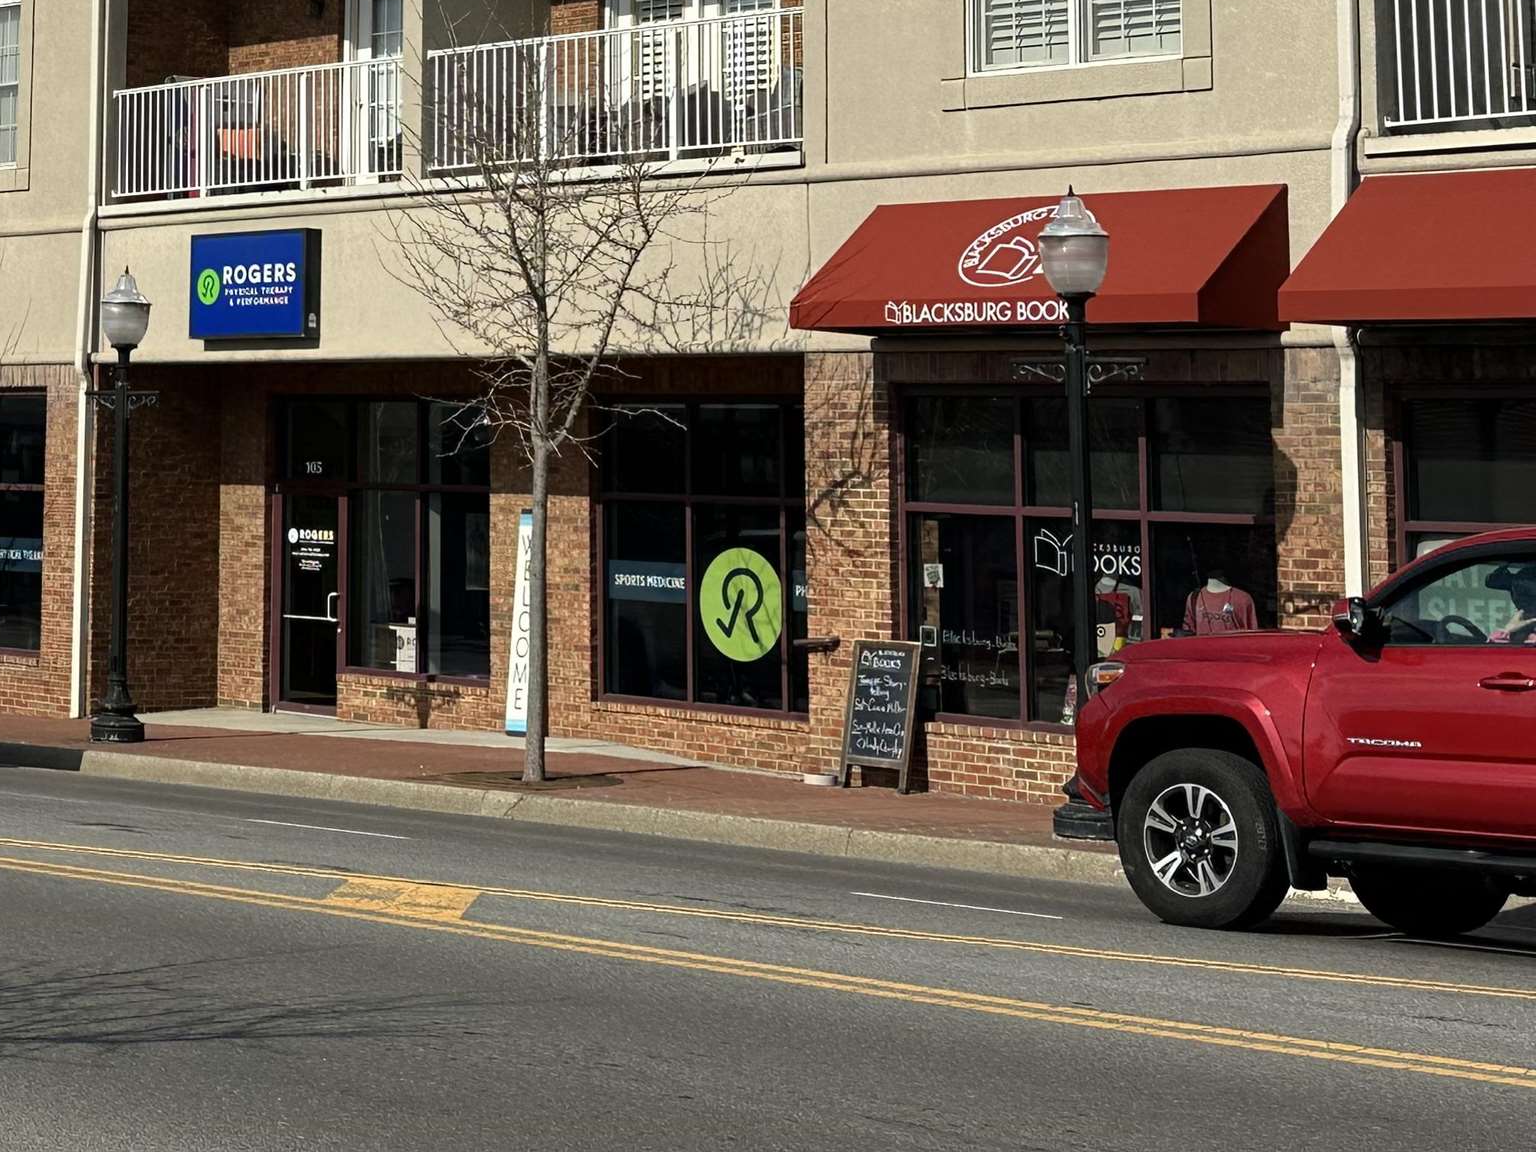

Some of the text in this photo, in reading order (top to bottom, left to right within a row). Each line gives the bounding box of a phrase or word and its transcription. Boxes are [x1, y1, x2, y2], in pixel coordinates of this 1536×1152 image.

[223, 262, 296, 285] ROGERS
[902, 300, 1071, 324] BLACKSBURG BOOK
[299, 529, 334, 541] ROGERS
[614, 574, 686, 590] SPORTS MEDICINE
[1346, 736, 1423, 748] TACOMA
